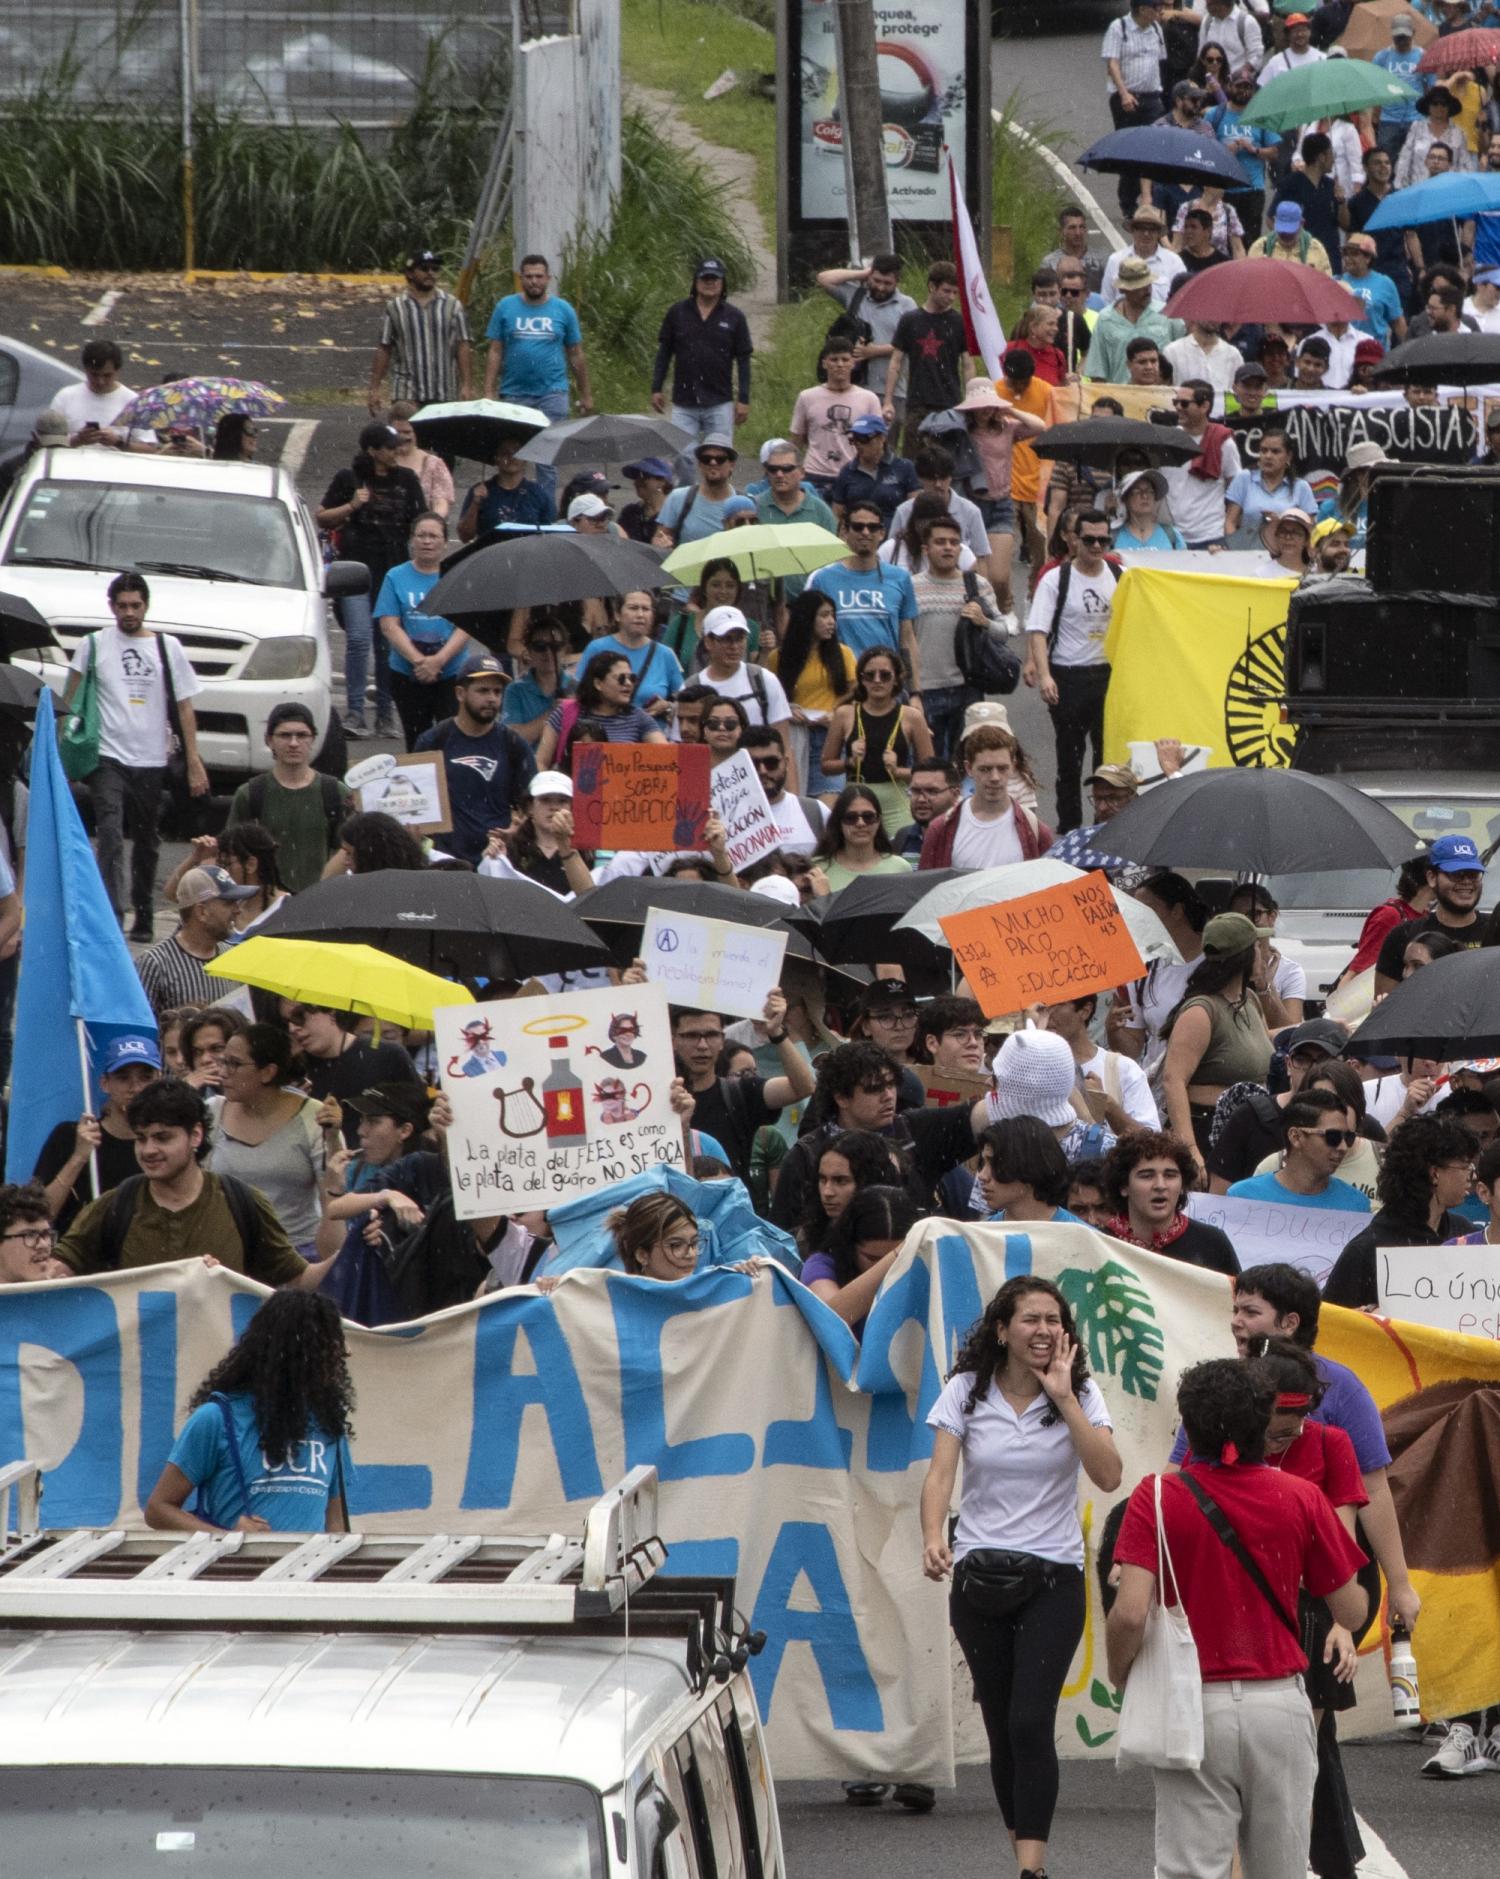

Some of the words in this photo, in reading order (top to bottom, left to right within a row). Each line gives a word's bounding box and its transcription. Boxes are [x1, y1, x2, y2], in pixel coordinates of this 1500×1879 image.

[882, 23, 939, 37] protege
[891, 187, 937, 196] Activado
[515, 316, 553, 332] UCR
[838, 589, 887, 609] UCR
[1073, 884, 1106, 907] NOS
[991, 904, 1064, 938] MUCHO
[1100, 921, 1118, 937] 43
[956, 941, 991, 963] 1312
[1005, 931, 1053, 958] PACO
[1048, 944, 1090, 968] POCA
[118, 1040, 146, 1053] UCR
[466, 1138, 490, 1161] La
[498, 1140, 536, 1169] plata
[547, 1151, 570, 1172] del
[577, 1139, 616, 1170] FEES
[620, 1131, 635, 1151] es
[638, 1124, 667, 1138] como
[455, 1166, 471, 1192] la
[476, 1160, 514, 1199] plata
[523, 1173, 548, 1192] del
[602, 1161, 626, 1183] NO
[631, 1151, 650, 1176] SE
[650, 1139, 684, 1163] TOCA
[1384, 1255, 1435, 1299] La
